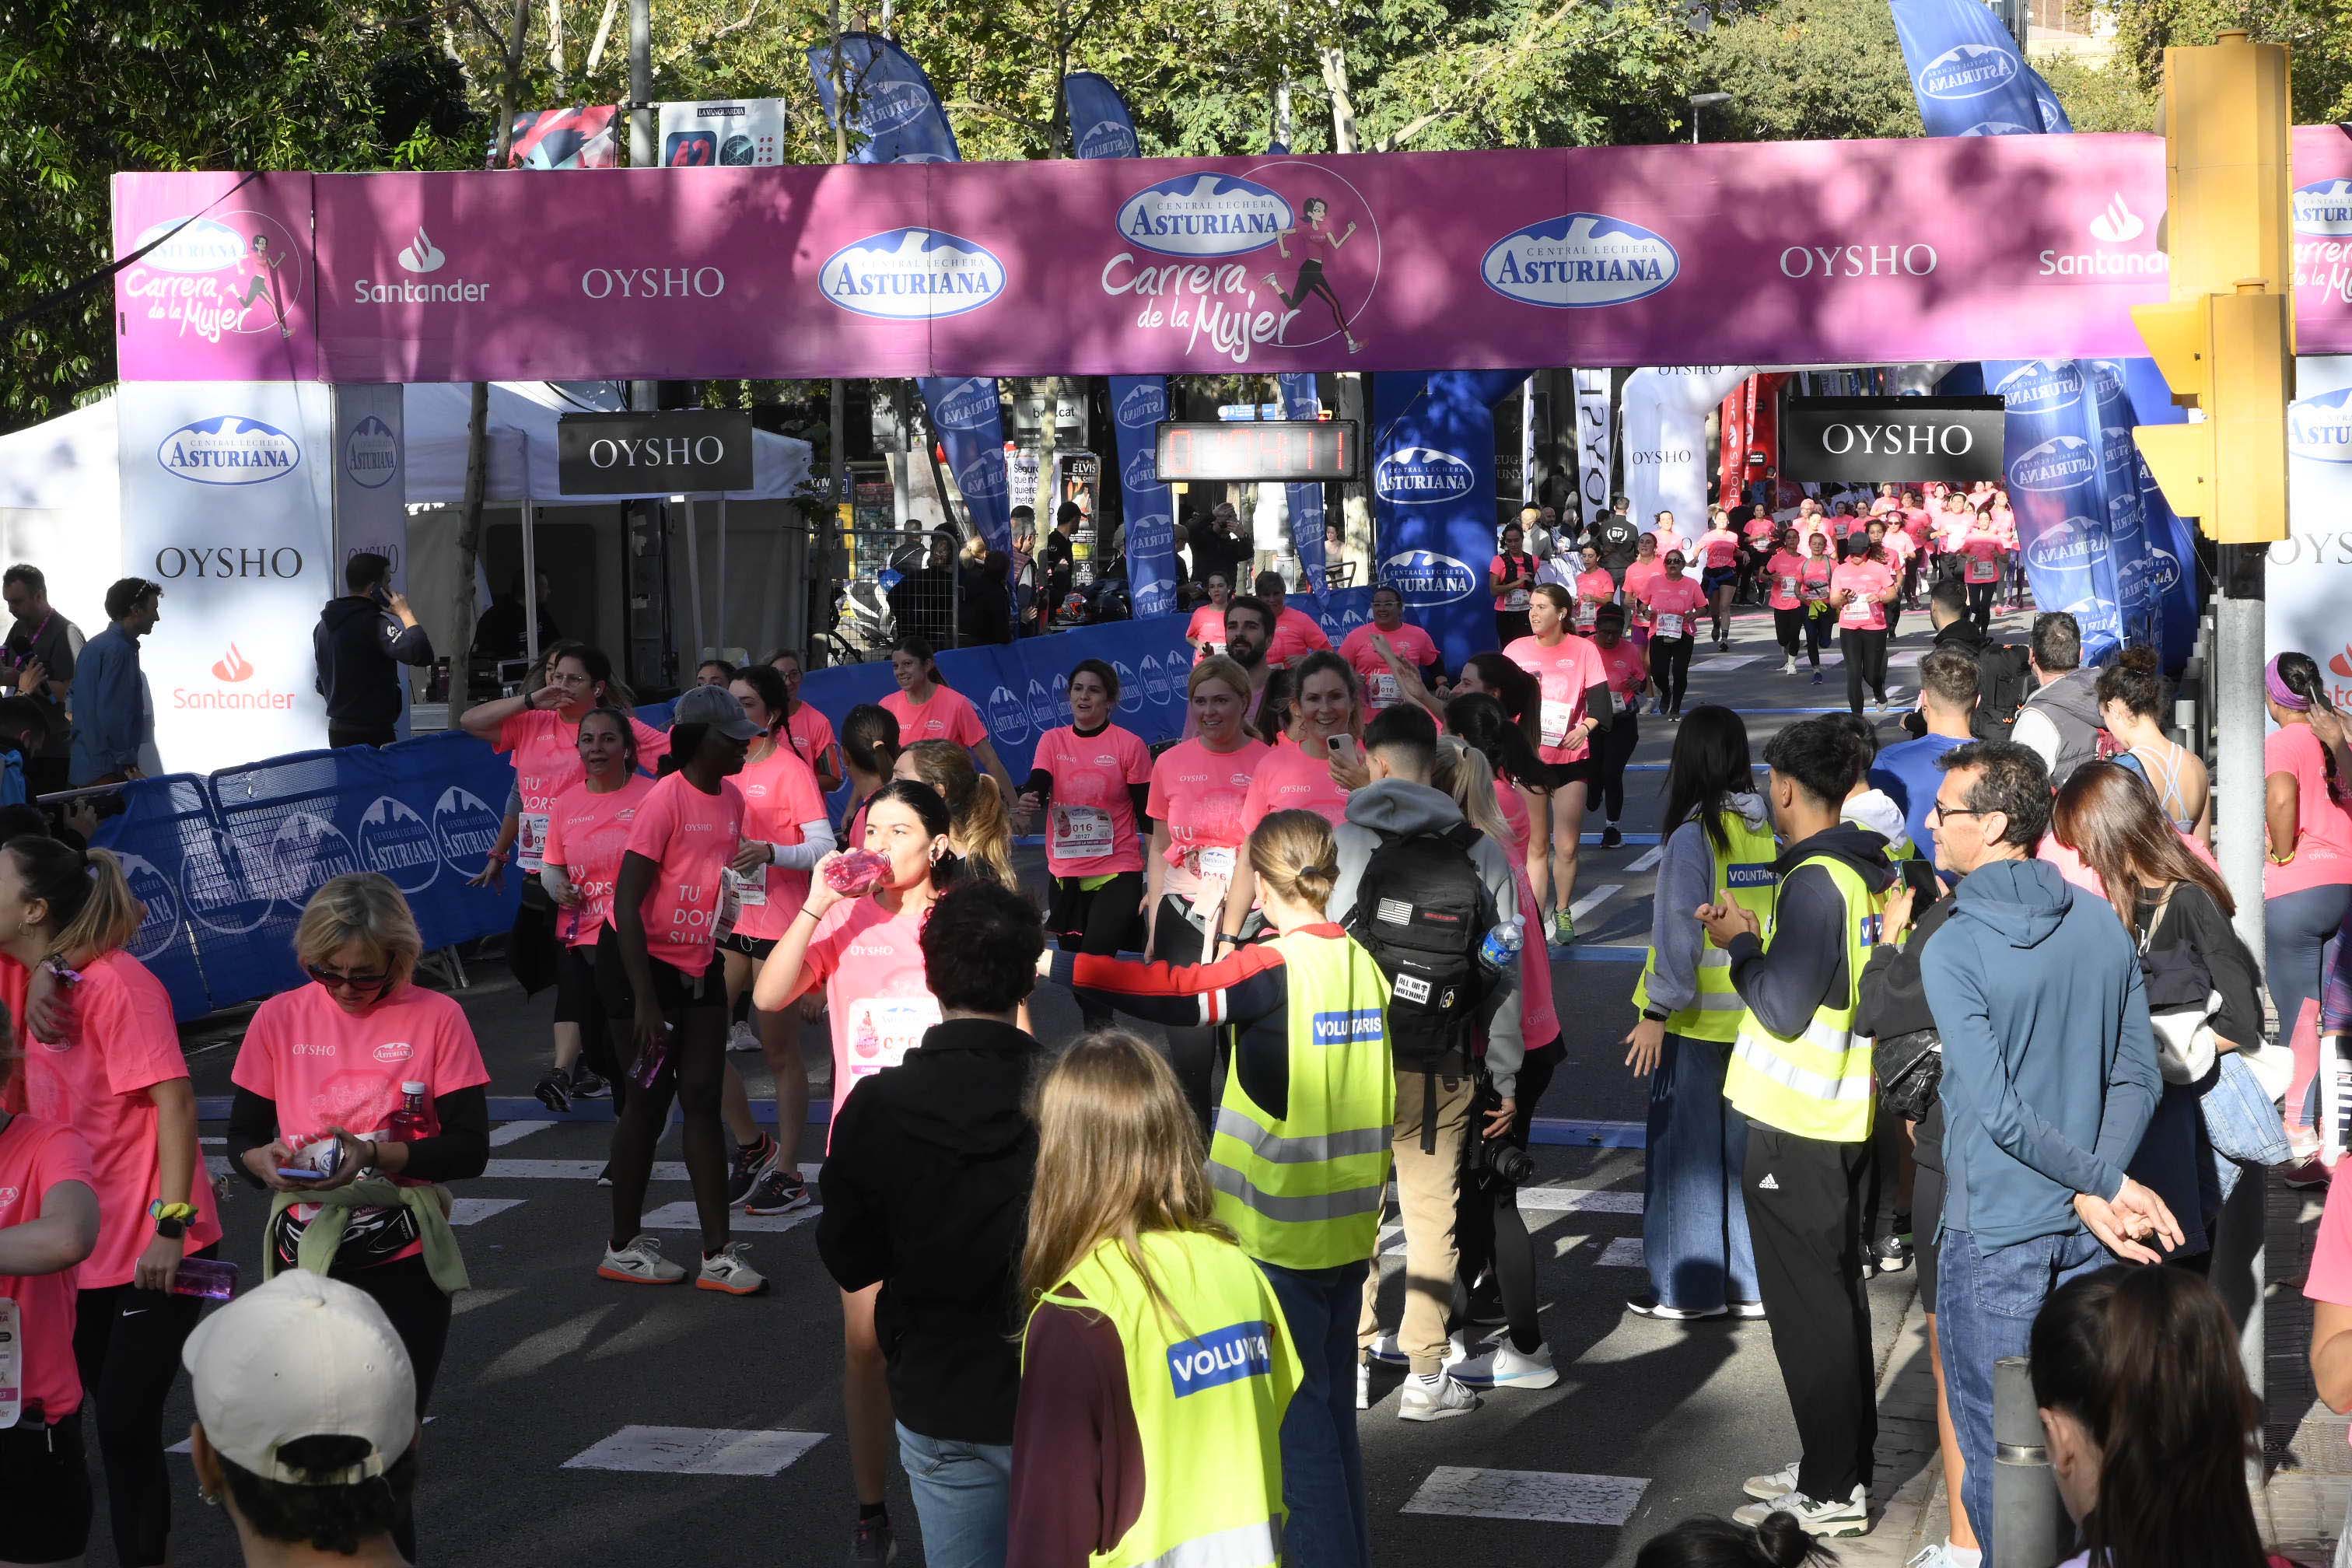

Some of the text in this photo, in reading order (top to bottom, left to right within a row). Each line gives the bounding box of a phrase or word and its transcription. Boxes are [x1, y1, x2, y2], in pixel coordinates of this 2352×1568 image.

[1157, 199, 1274, 209] CENTRAL LECHERA
[1131, 206, 1278, 236] ASTURIANA
[1527, 244, 1657, 256] CENTRAL LECHERA
[1780, 243, 1938, 279] OYSHO
[926, 257, 986, 268] LECHERA
[1496, 250, 1664, 285] ASTURIANA
[2039, 250, 2170, 277] Santand
[125, 267, 219, 299] Carrera
[582, 266, 725, 299] OYSHO
[834, 261, 991, 296] ASTURIANA
[1101, 252, 1246, 296] Carrera
[355, 278, 490, 303] Santander
[148, 296, 253, 343] de la Mujer
[1137, 290, 1302, 363] de la Mujer
[1822, 423, 1973, 456] OYSHO
[169, 441, 290, 468] ASTURIANA
[589, 436, 724, 468] OYSHO
[1633, 450, 1692, 465] OYSHO
[1073, 464, 1096, 473] ELVIS
[1379, 470, 1467, 492] ASTURIANA
[2268, 532, 2352, 566] OYS
[155, 547, 303, 579] OYSHO
[1080, 563, 1090, 572] 30
[173, 688, 295, 710] Santander
[524, 777, 541, 790] TU
[1179, 774, 1208, 782] OYSHO
[1280, 785, 1311, 793] OYSHO
[523, 795, 558, 810] DORS
[684, 823, 712, 831] OYSHO
[1073, 823, 1093, 832] 016
[1172, 825, 1194, 842] TU
[366, 836, 436, 873] ASTURIANA
[679, 884, 700, 902] TU
[850, 945, 894, 956] OYSHO
[1395, 987, 1426, 1002] NOTHING
[1399, 977, 1421, 990] ALL OR
[1315, 1017, 1382, 1038] VOLUTARIS
[292, 1044, 336, 1057] OYSHO
[1173, 1335, 1269, 1381] VOLUNTA
